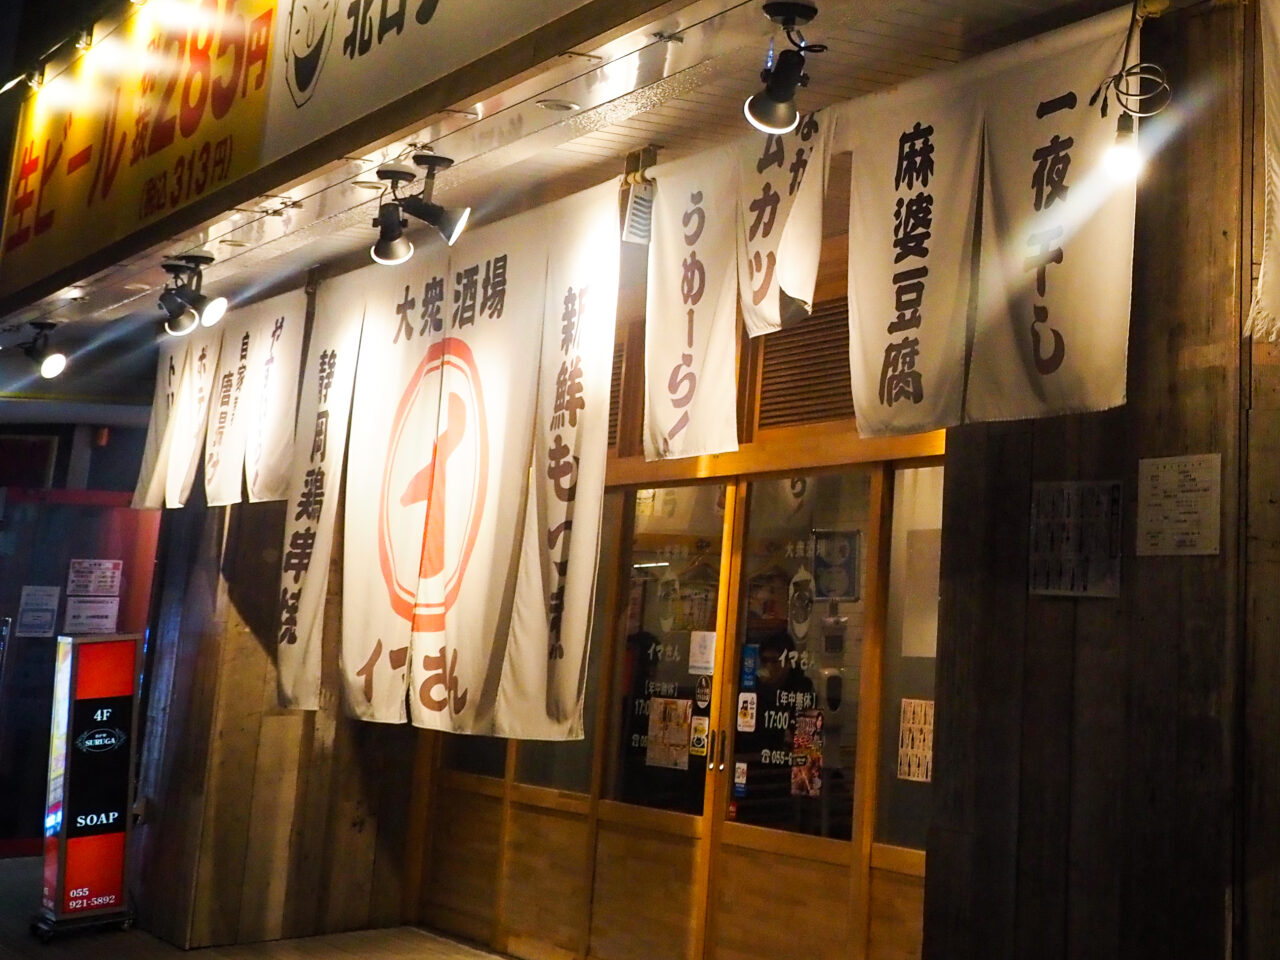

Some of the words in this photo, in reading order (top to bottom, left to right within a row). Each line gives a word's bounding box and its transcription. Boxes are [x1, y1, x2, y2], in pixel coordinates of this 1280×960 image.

[1022, 90, 1078, 376] 一夜干し
[879, 122, 936, 408] 麻婆豆腐
[393, 253, 508, 344] 大衆酒場
[94, 708, 112, 721] 4F
[85, 738, 116, 747] SURUGA
[76, 811, 119, 827] SOAP
[70, 888, 89, 897] 055
